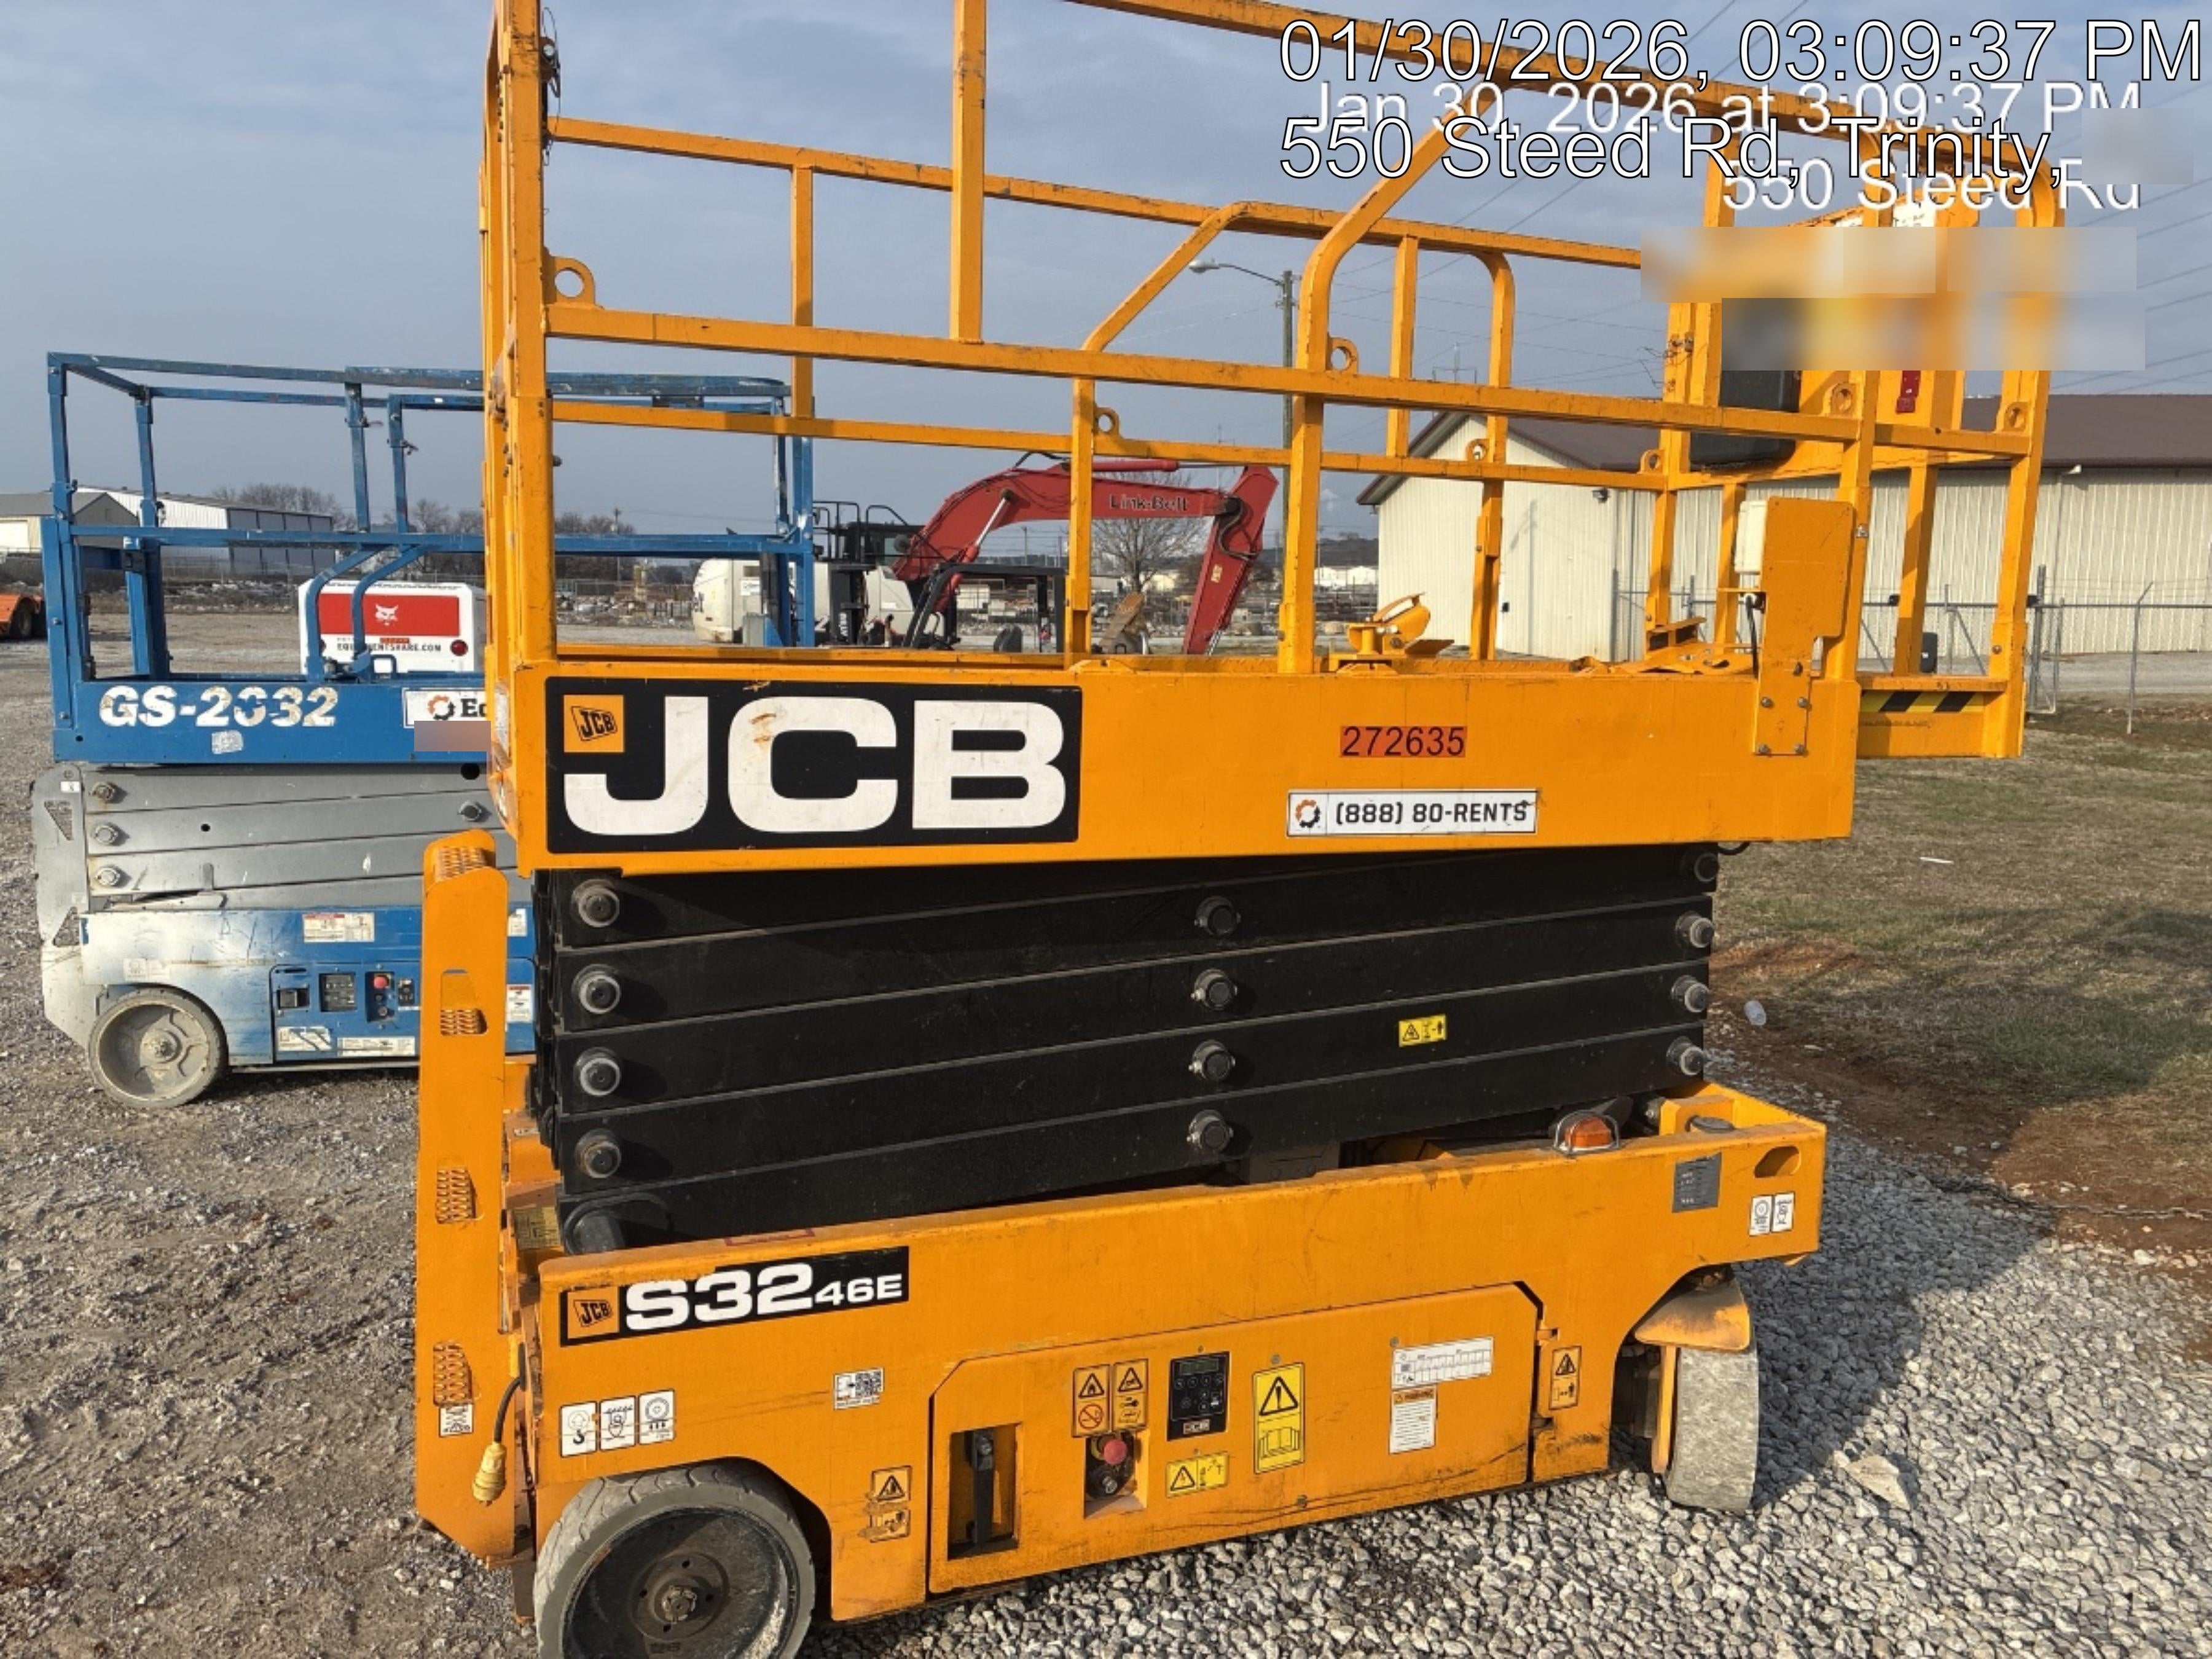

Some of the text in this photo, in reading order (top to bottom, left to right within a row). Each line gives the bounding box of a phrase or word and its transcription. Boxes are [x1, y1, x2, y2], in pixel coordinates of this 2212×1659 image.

[99, 685, 338, 728] GS-2032
[580, 710, 615, 737] JCB
[1342, 726, 1465, 756] 272635
[563, 696, 1067, 836] JCB
[1336, 802, 1528, 825] (888) 80-RENTS
[579, 1301, 613, 1325] JCB
